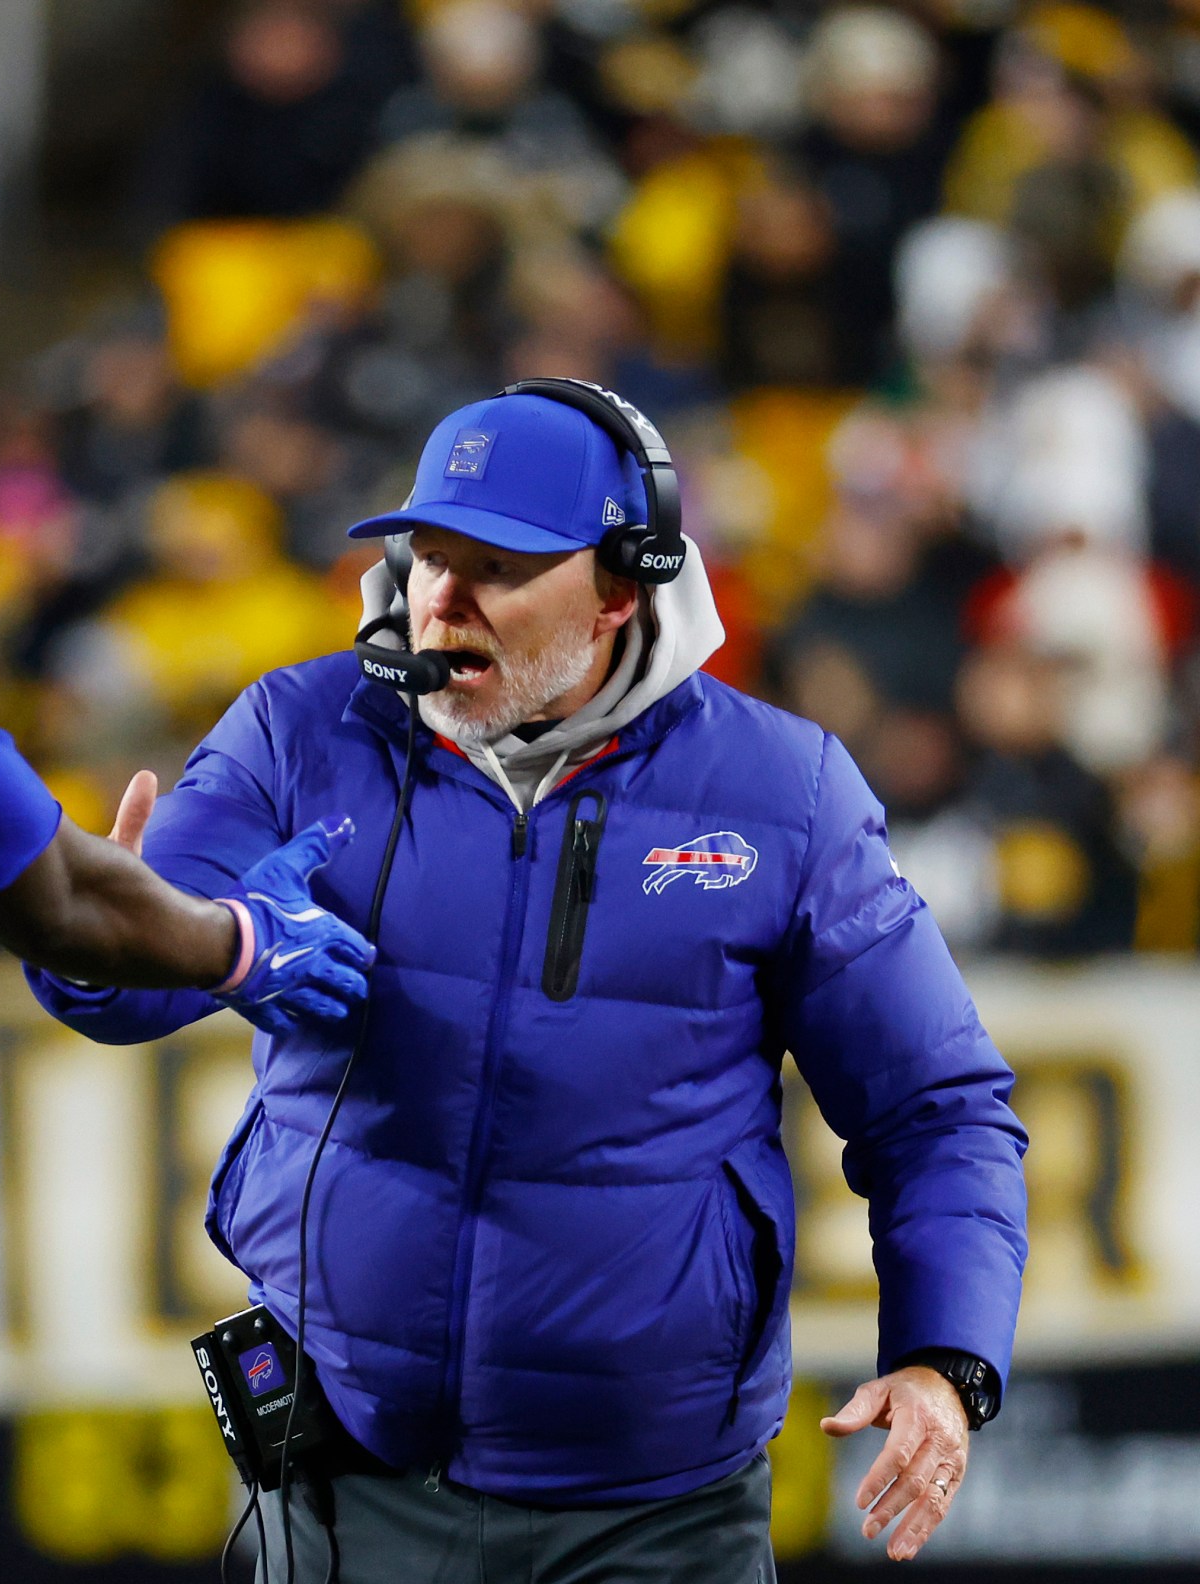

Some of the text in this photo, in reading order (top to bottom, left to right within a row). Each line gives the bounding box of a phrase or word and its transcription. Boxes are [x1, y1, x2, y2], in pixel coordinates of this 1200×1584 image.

[640, 553, 683, 569] SONY
[363, 659, 408, 683] SONY
[196, 1346, 236, 1441] SONY
[256, 1392, 295, 1417] MCDERMOTT
